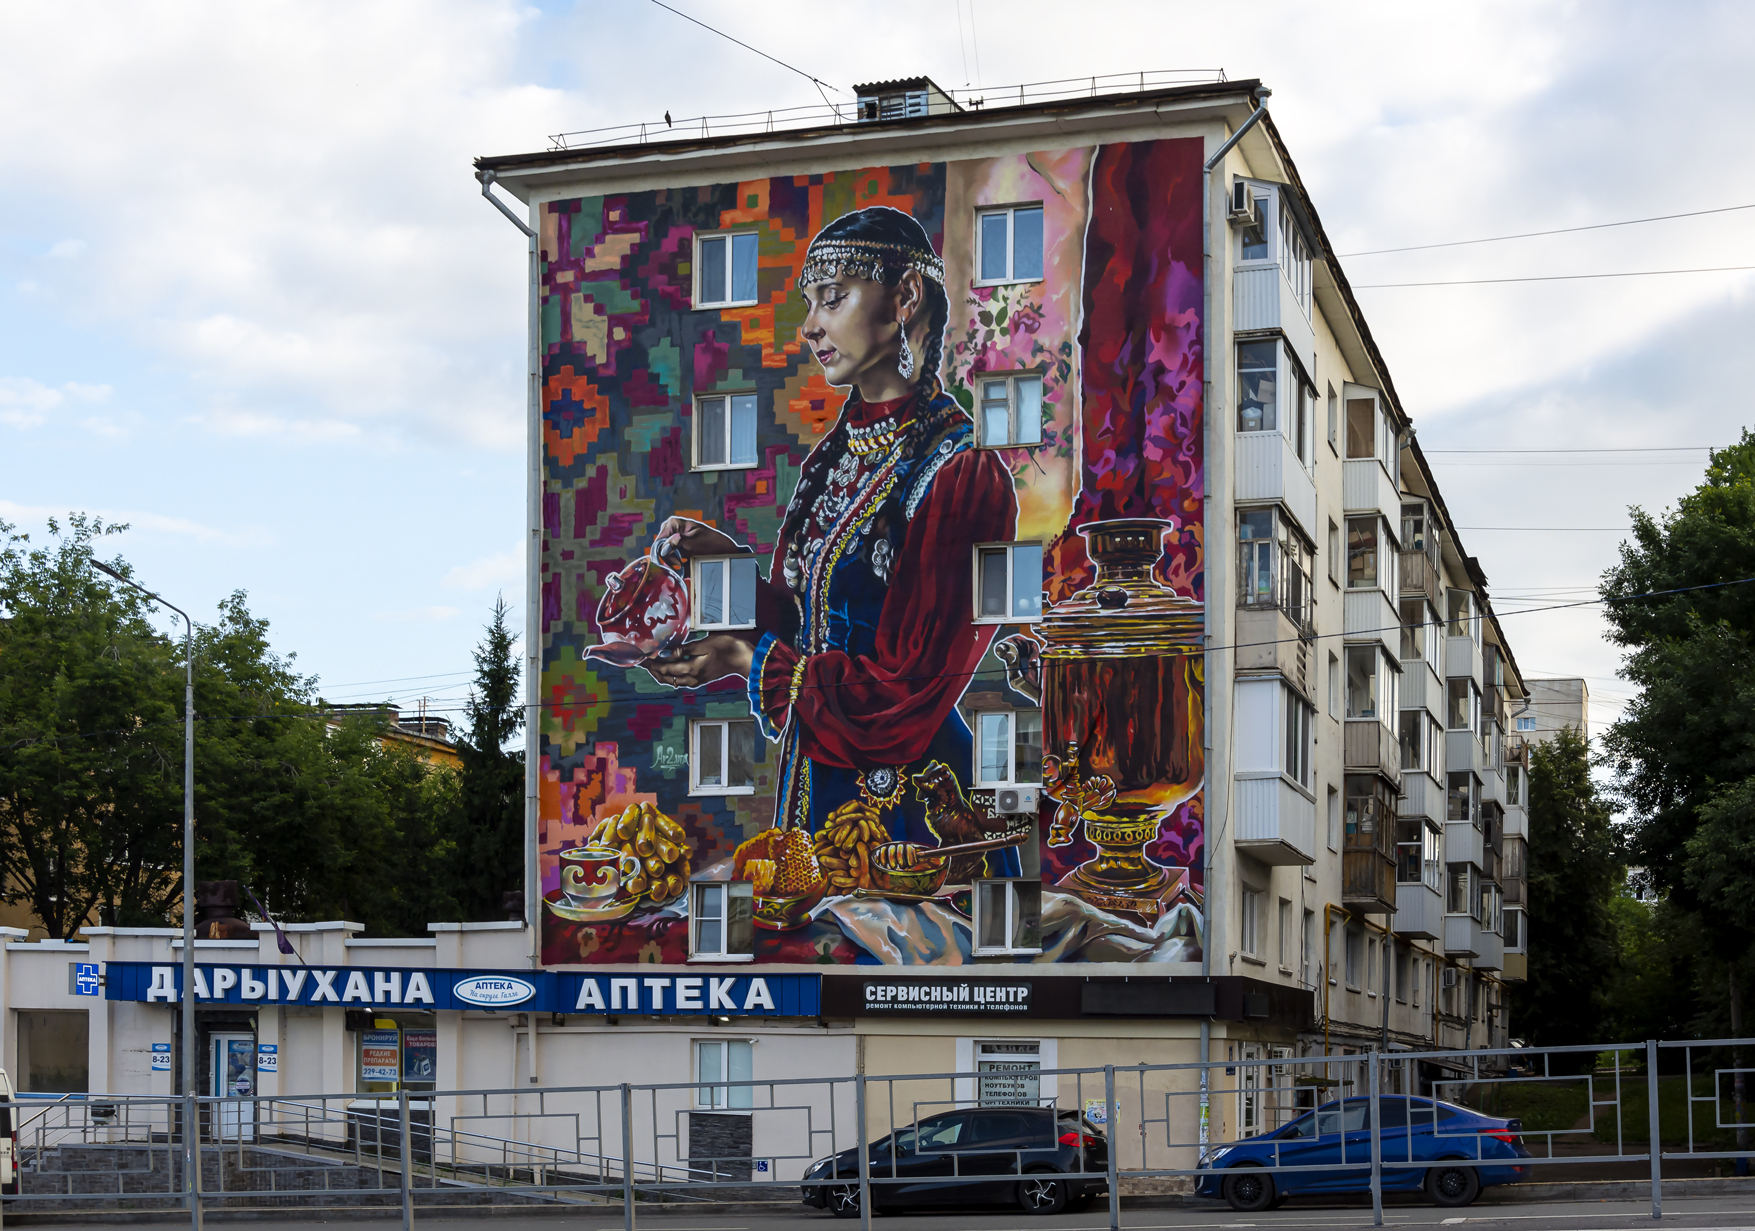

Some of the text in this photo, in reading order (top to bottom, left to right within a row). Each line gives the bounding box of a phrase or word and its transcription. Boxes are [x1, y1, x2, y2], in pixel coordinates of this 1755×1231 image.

[147, 966, 435, 1004] ДАРЫУХАНА
[475, 982, 513, 990] АПТЕКА
[575, 977, 776, 1010] АПТЕКА
[865, 983, 1029, 1004] СЕРВИСНЫЙ ЦЕНТР
[152, 1055, 170, 1064] 8-23
[258, 1056, 277, 1065] 8-23
[363, 1068, 397, 1076] 229-42-73
[989, 1064, 1033, 1072] РЕМОНТ
